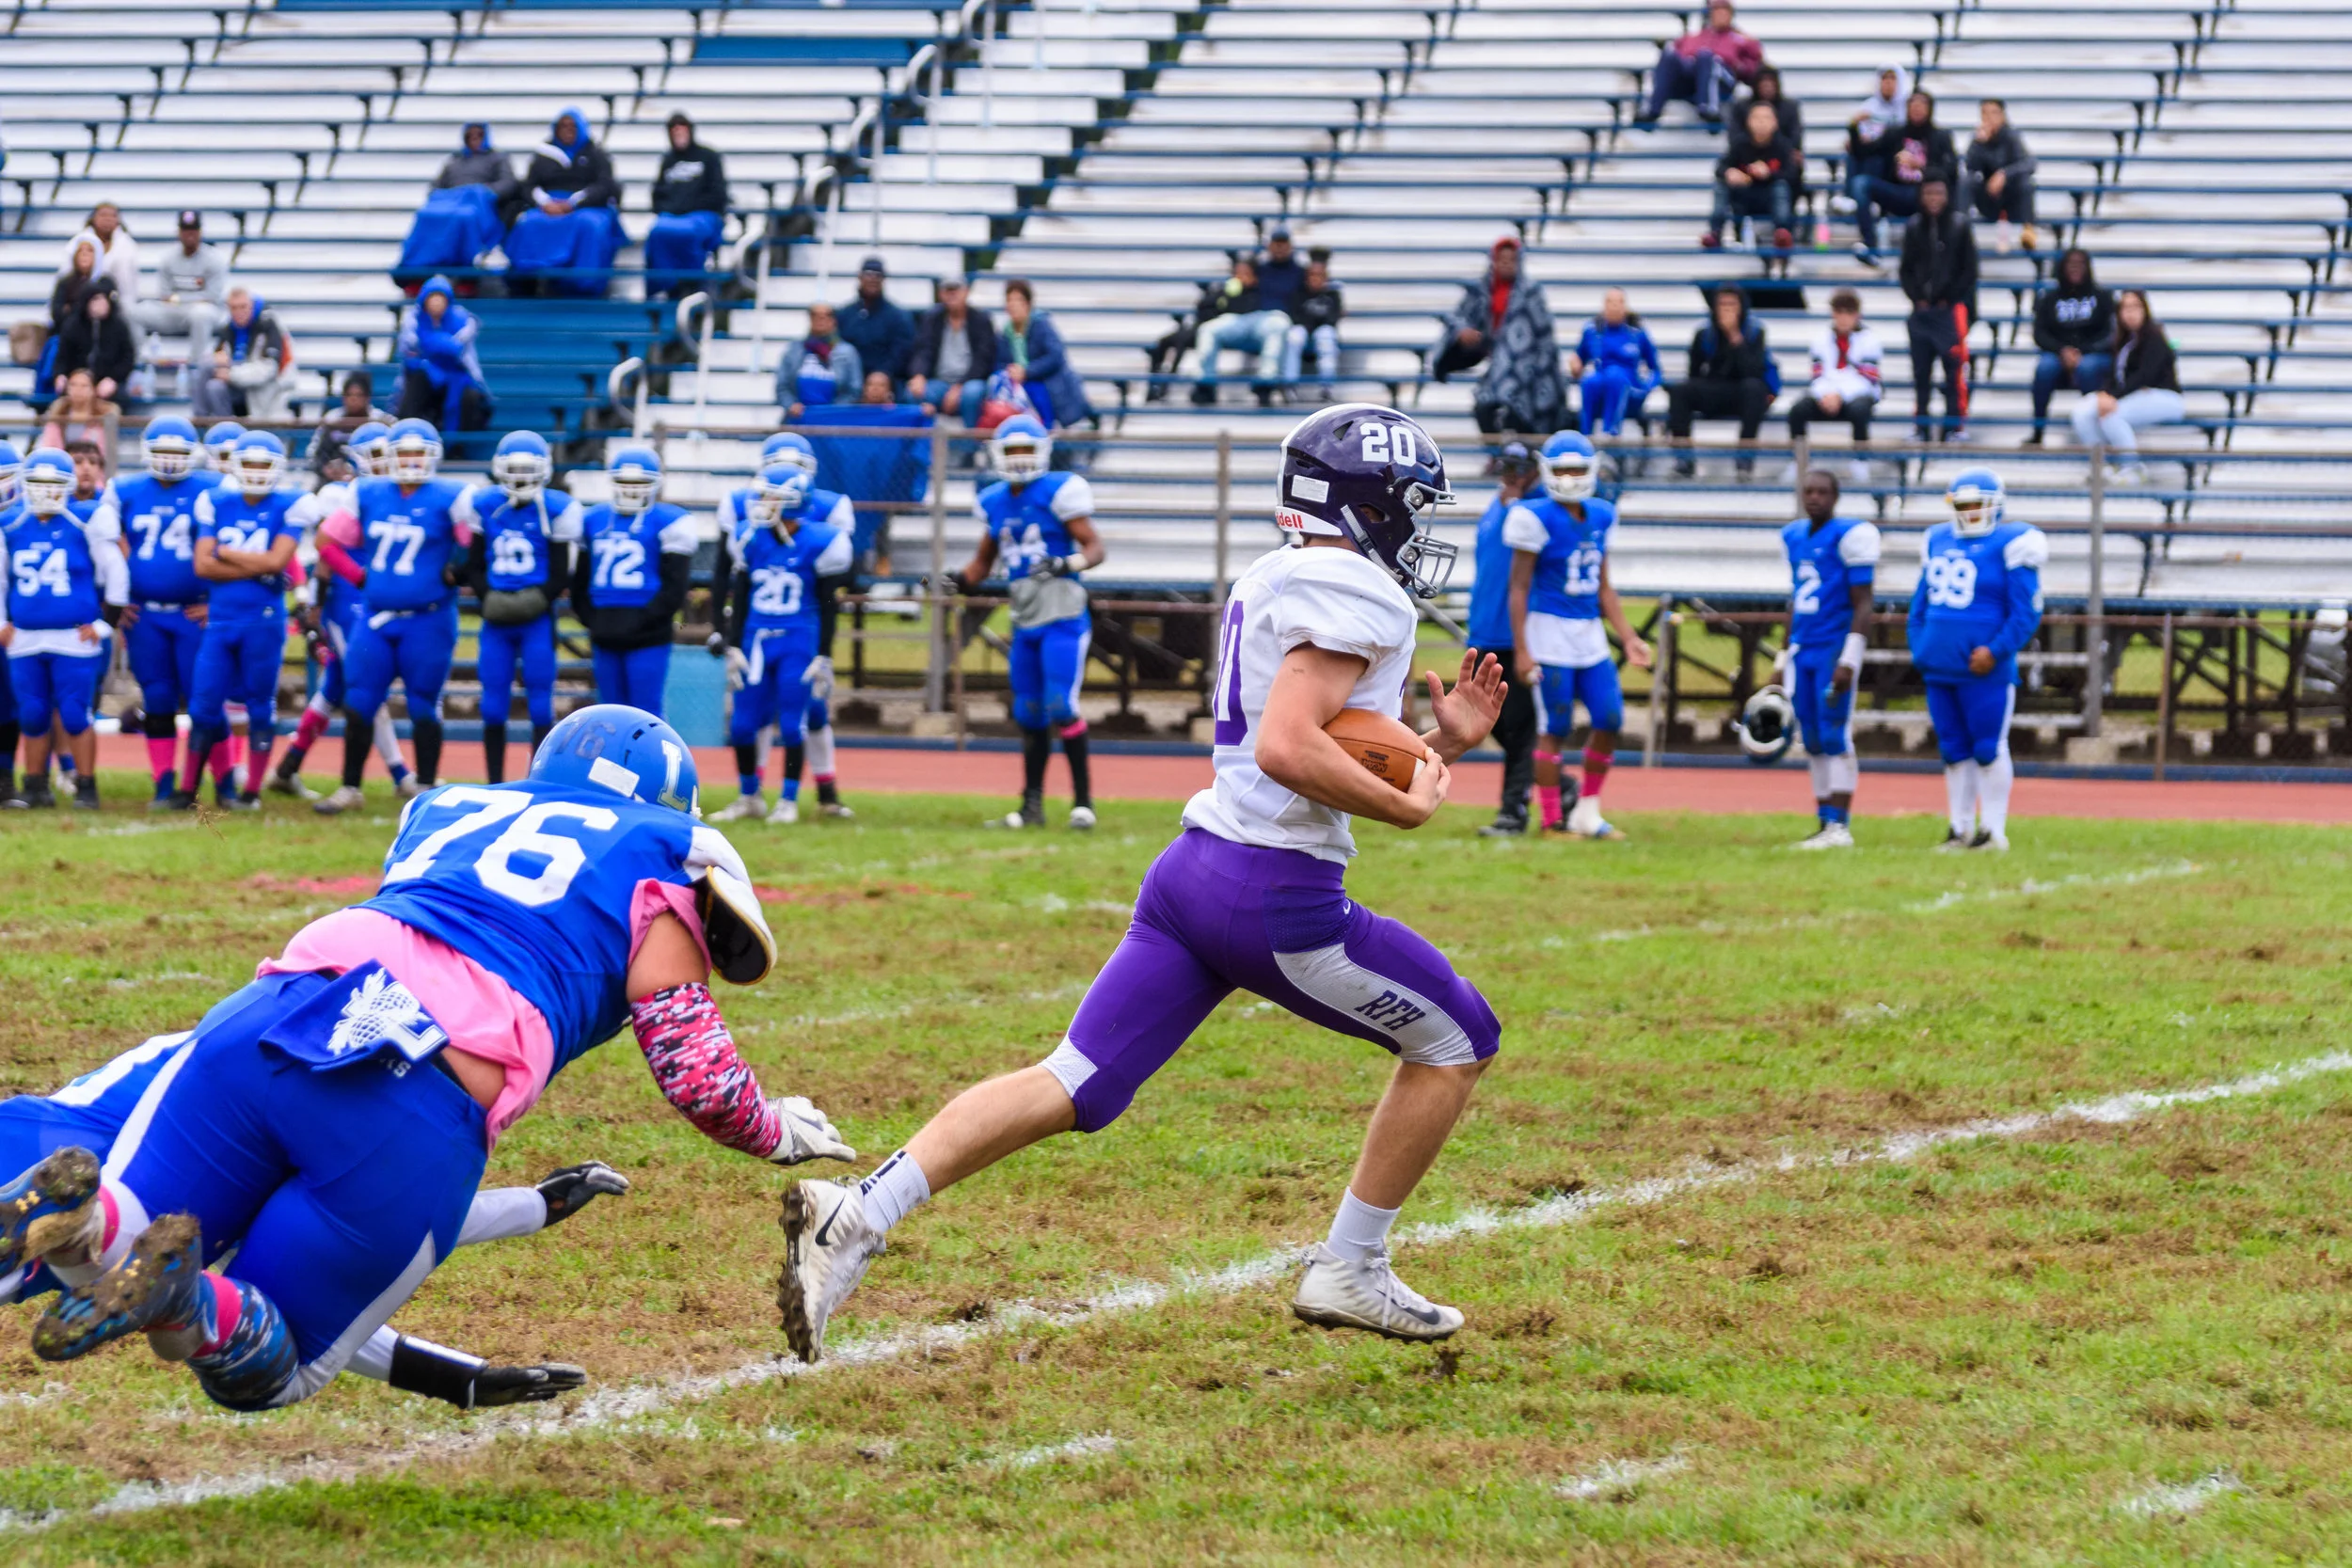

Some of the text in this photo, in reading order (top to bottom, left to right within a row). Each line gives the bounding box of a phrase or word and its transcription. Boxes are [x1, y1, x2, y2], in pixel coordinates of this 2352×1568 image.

[1359, 422, 1417, 467] 20
[132, 514, 194, 561] 74
[1276, 512, 1303, 529] dell
[13, 548, 72, 597] 54
[368, 520, 425, 576] 77
[593, 538, 645, 589] 72
[1565, 548, 1603, 596] 13
[752, 568, 803, 615] 20
[1794, 564, 1822, 614] 2
[1926, 556, 1978, 610] 99
[1214, 600, 1248, 746] 0
[385, 786, 619, 906] 76
[1353, 990, 1427, 1031] RFH
